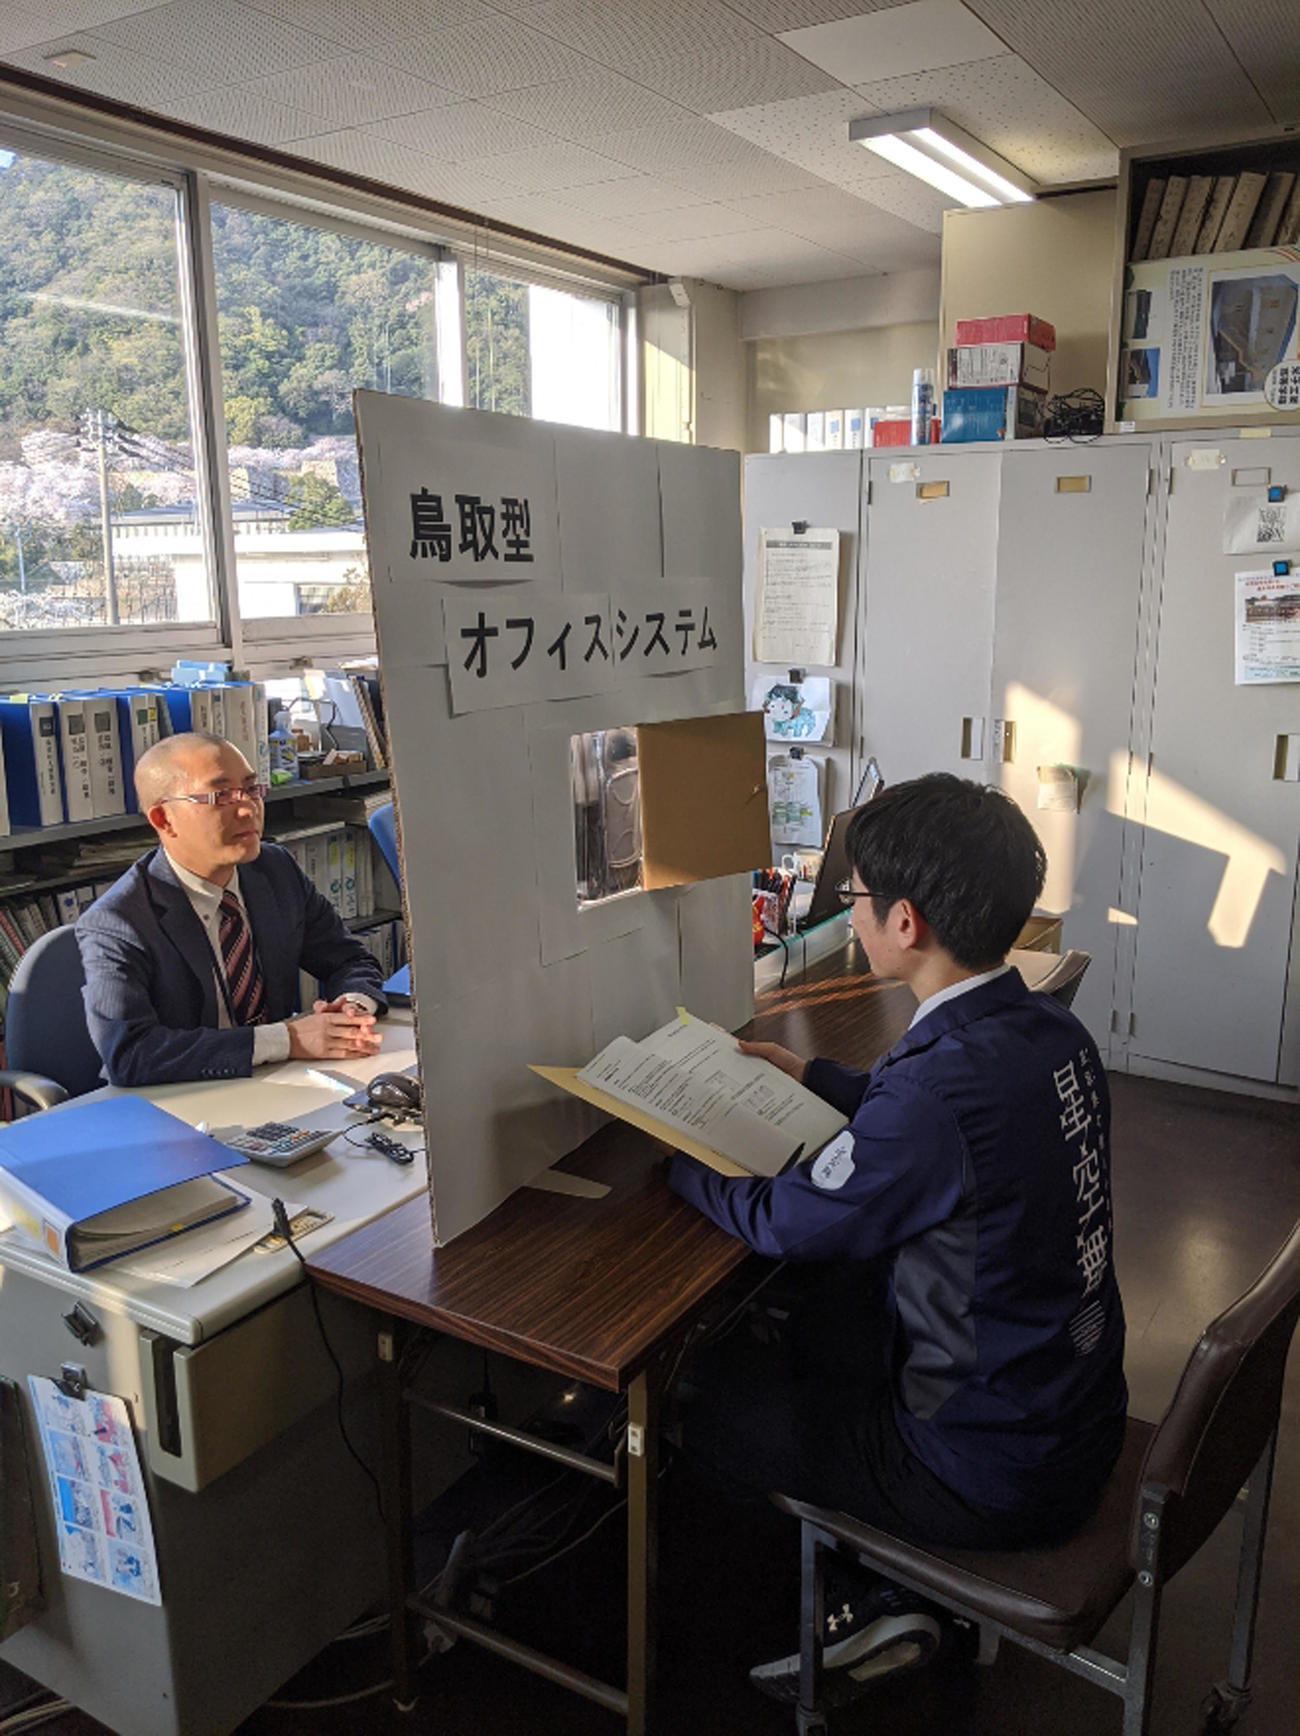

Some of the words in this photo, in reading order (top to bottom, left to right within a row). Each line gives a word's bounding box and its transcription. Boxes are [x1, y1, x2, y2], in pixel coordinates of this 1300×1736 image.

[409, 486, 535, 563] 鳥取型
[460, 606, 718, 679] オフィスシステム
